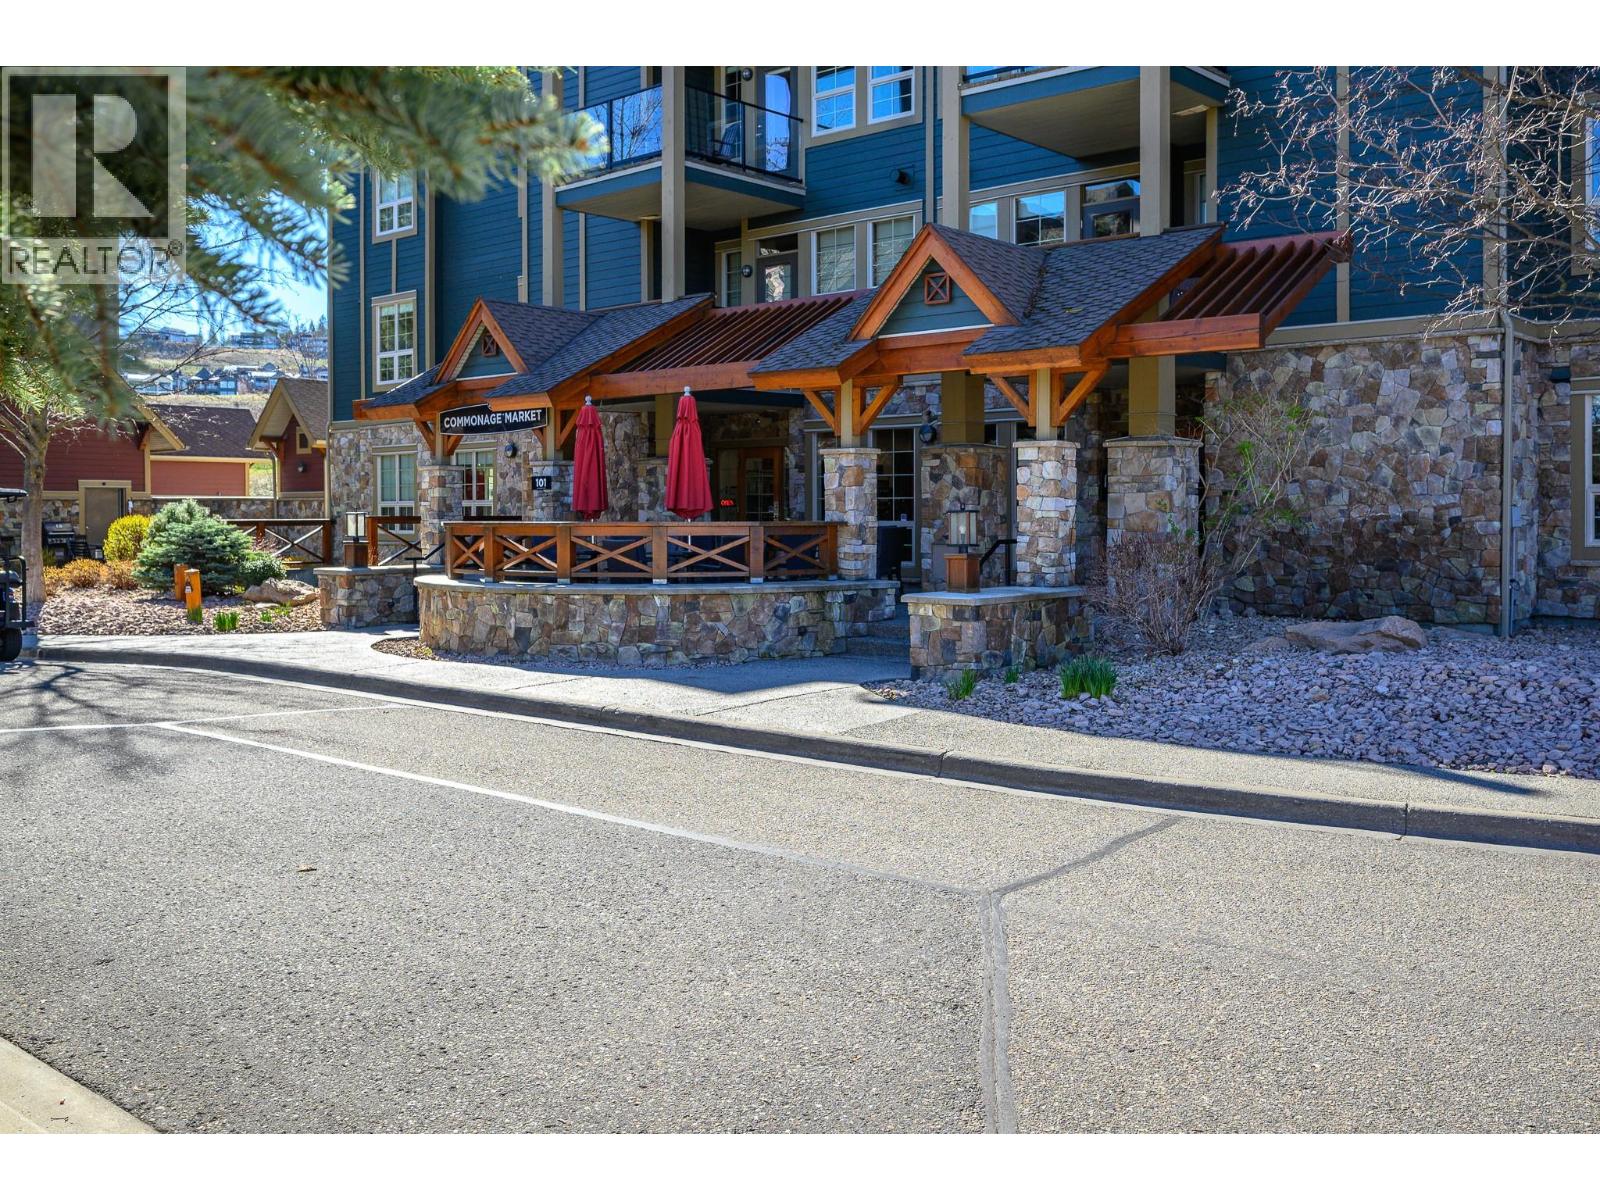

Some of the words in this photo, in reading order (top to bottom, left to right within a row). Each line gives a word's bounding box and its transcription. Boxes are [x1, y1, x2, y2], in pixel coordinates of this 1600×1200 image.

[444, 414, 502, 428] COMMONAGE
[504, 409, 542, 423] MARKET
[535, 478, 547, 488] 101
